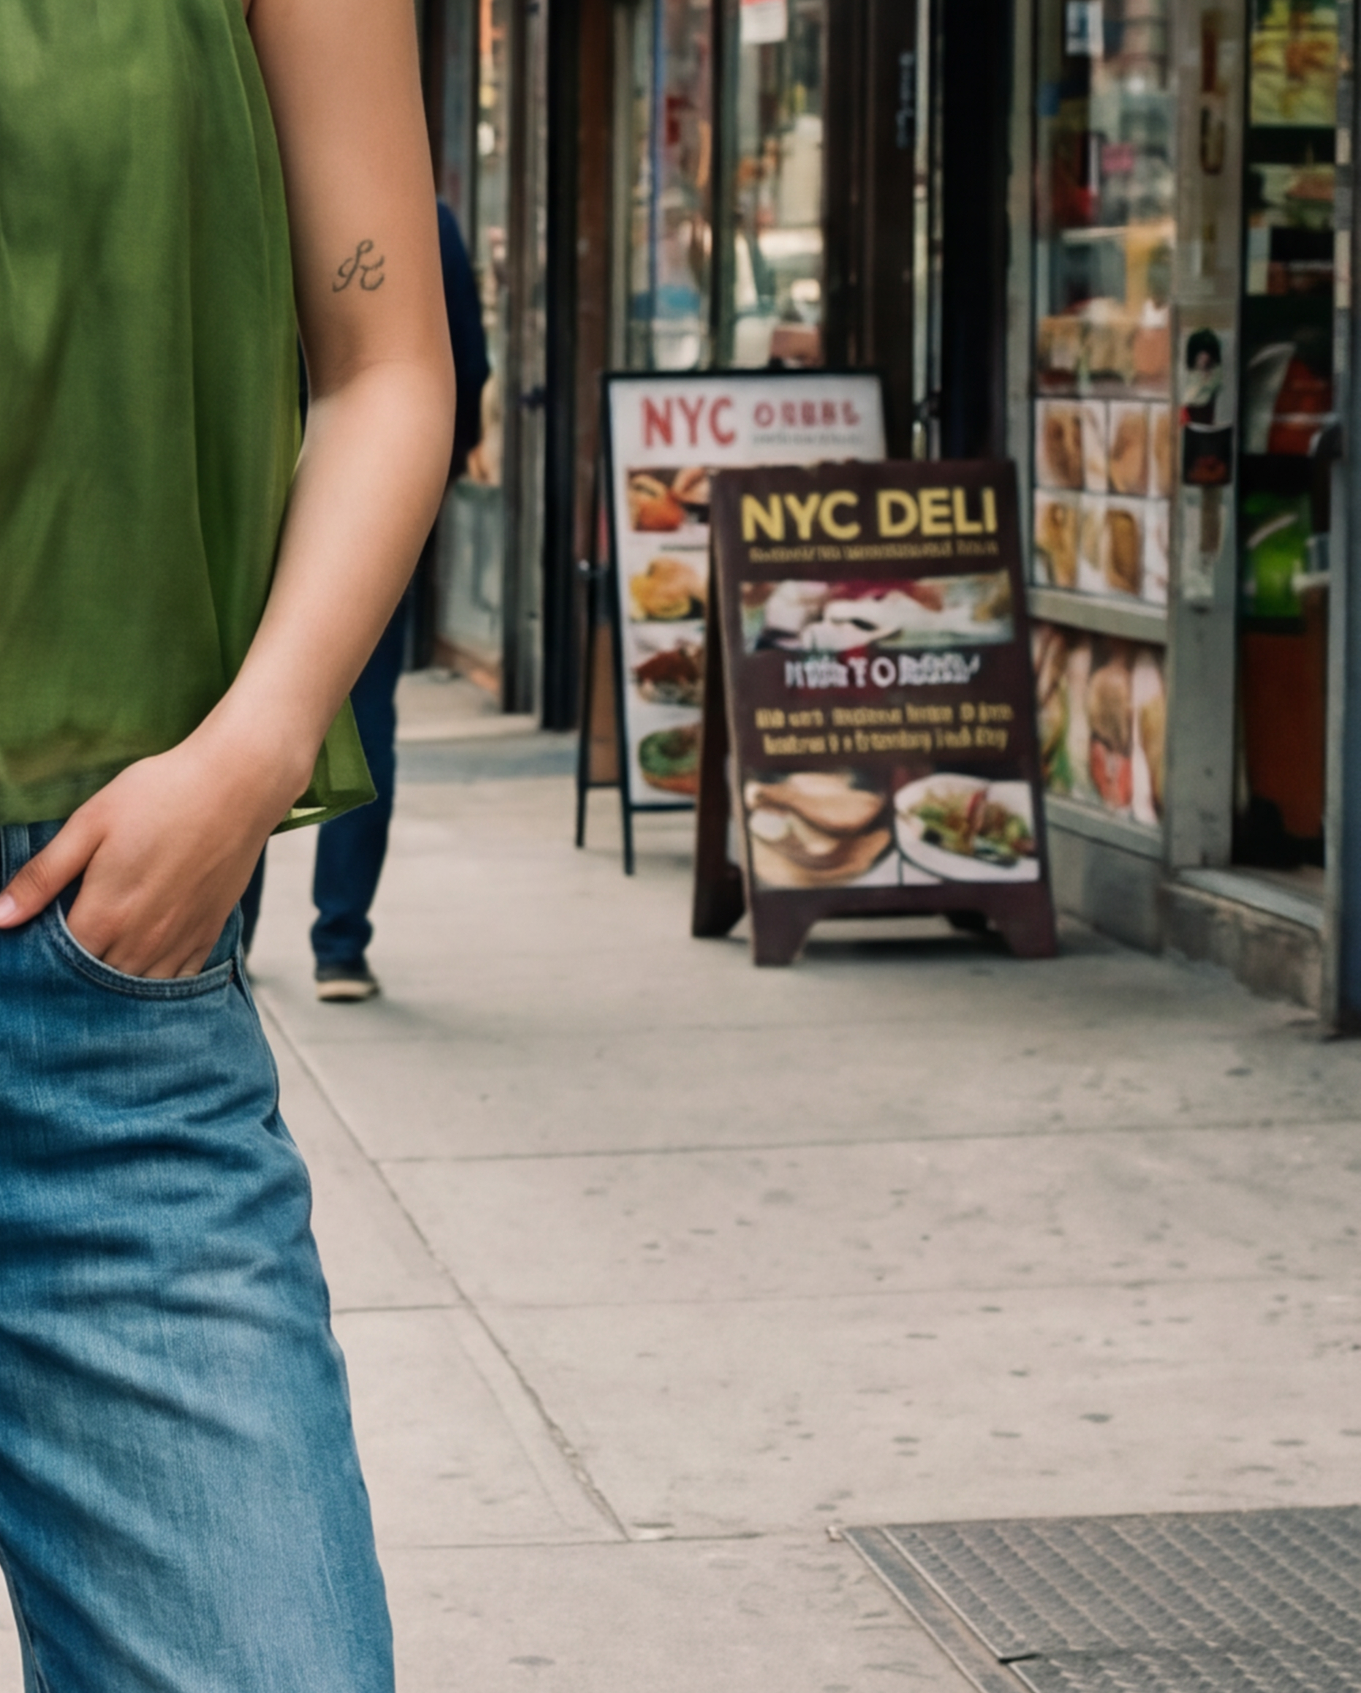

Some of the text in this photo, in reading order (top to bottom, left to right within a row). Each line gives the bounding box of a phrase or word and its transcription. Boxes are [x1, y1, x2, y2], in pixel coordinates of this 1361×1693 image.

[642, 396, 736, 449] NYC
[742, 486, 998, 542] NYC DELI
